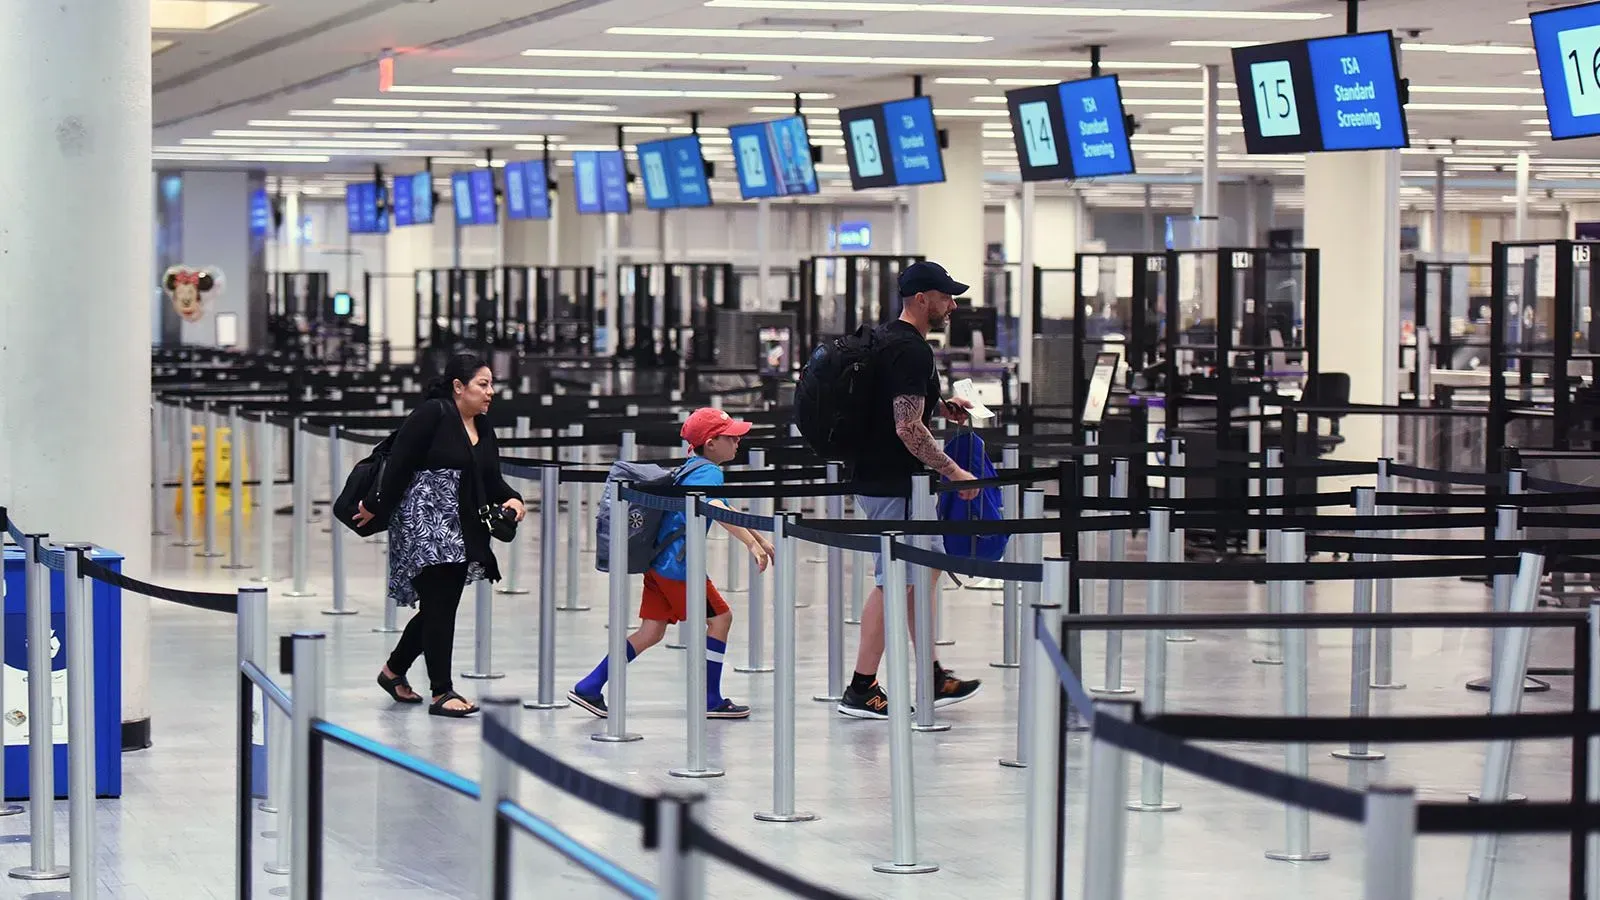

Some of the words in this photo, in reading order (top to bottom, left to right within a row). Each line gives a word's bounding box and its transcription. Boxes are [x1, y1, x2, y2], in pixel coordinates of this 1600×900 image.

[1340, 57, 1360, 75] TSA
[1259, 79, 1290, 119] 15
[1334, 81, 1376, 102] Standard
[1082, 97, 1097, 113] TSA
[1079, 117, 1109, 136] Standard
[1337, 108, 1381, 130] Screening
[1026, 117, 1051, 151] 14
[856, 132, 877, 163] 13
[1082, 140, 1115, 159] Screening
[1575, 246, 1588, 260] 15
